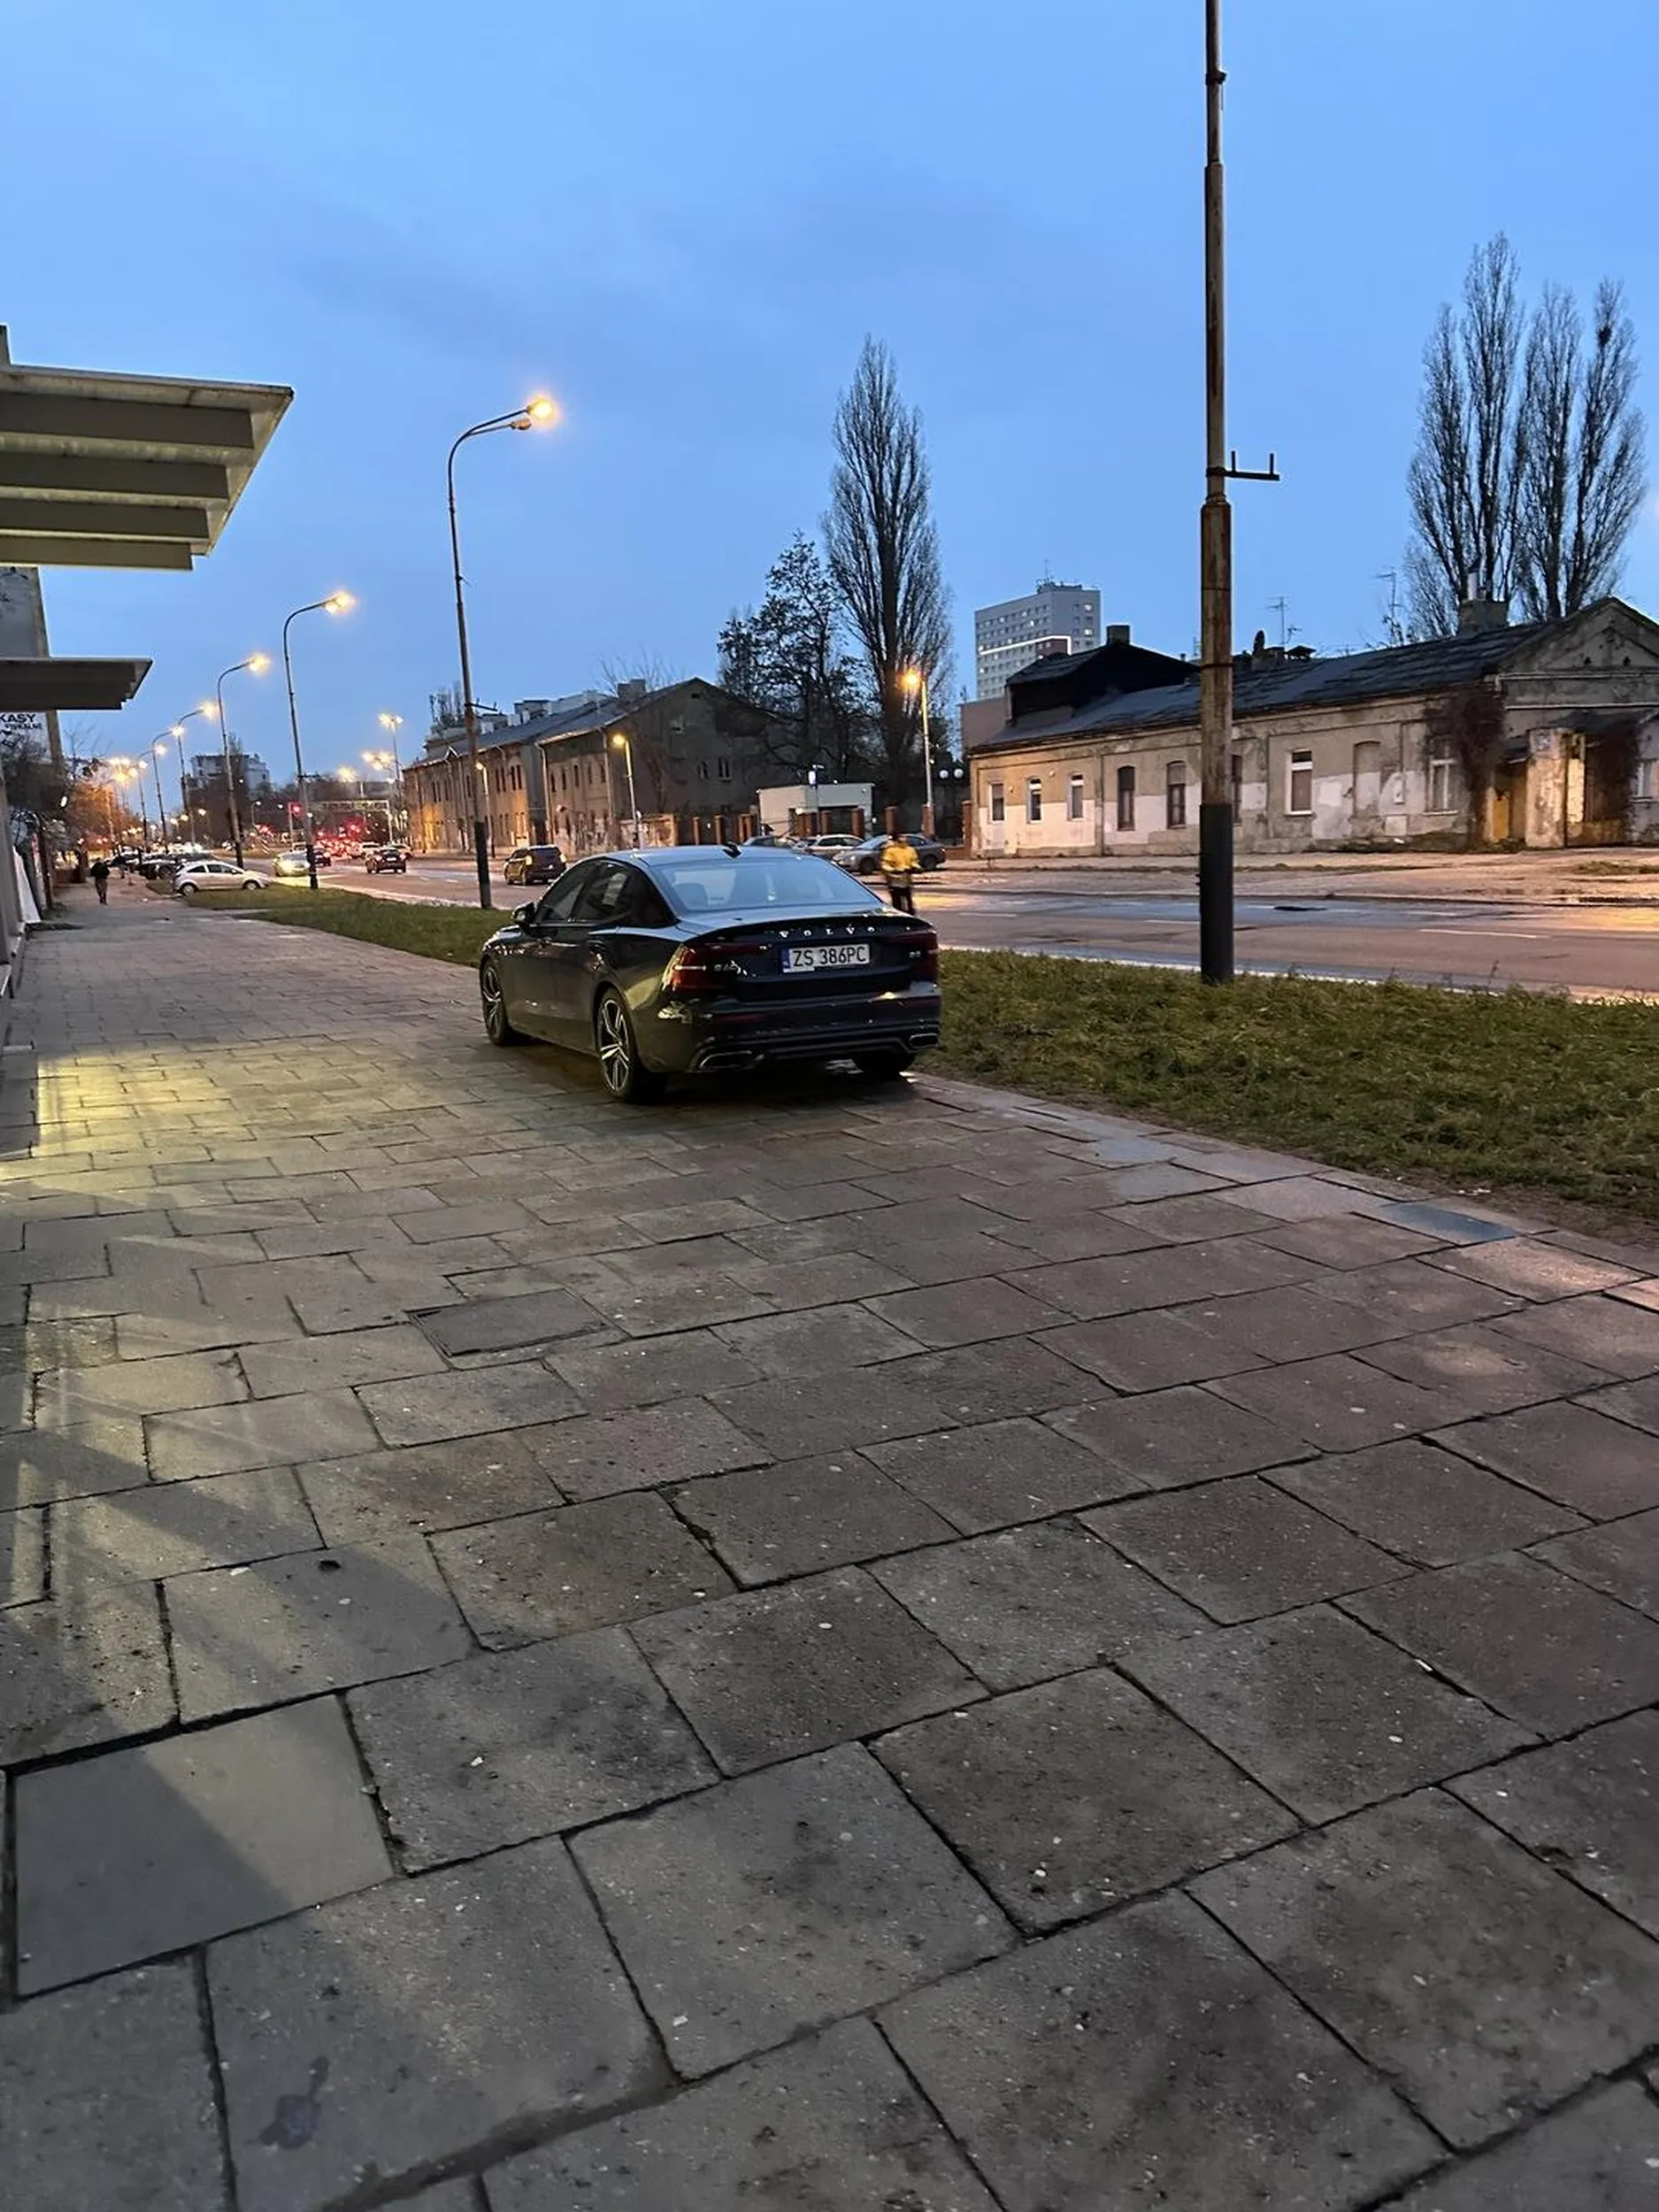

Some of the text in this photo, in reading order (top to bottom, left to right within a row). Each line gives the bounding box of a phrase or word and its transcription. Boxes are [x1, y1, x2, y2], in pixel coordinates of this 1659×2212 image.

[780, 926, 875, 938] VOLVO
[793, 946, 866, 966] ZS 386PC
